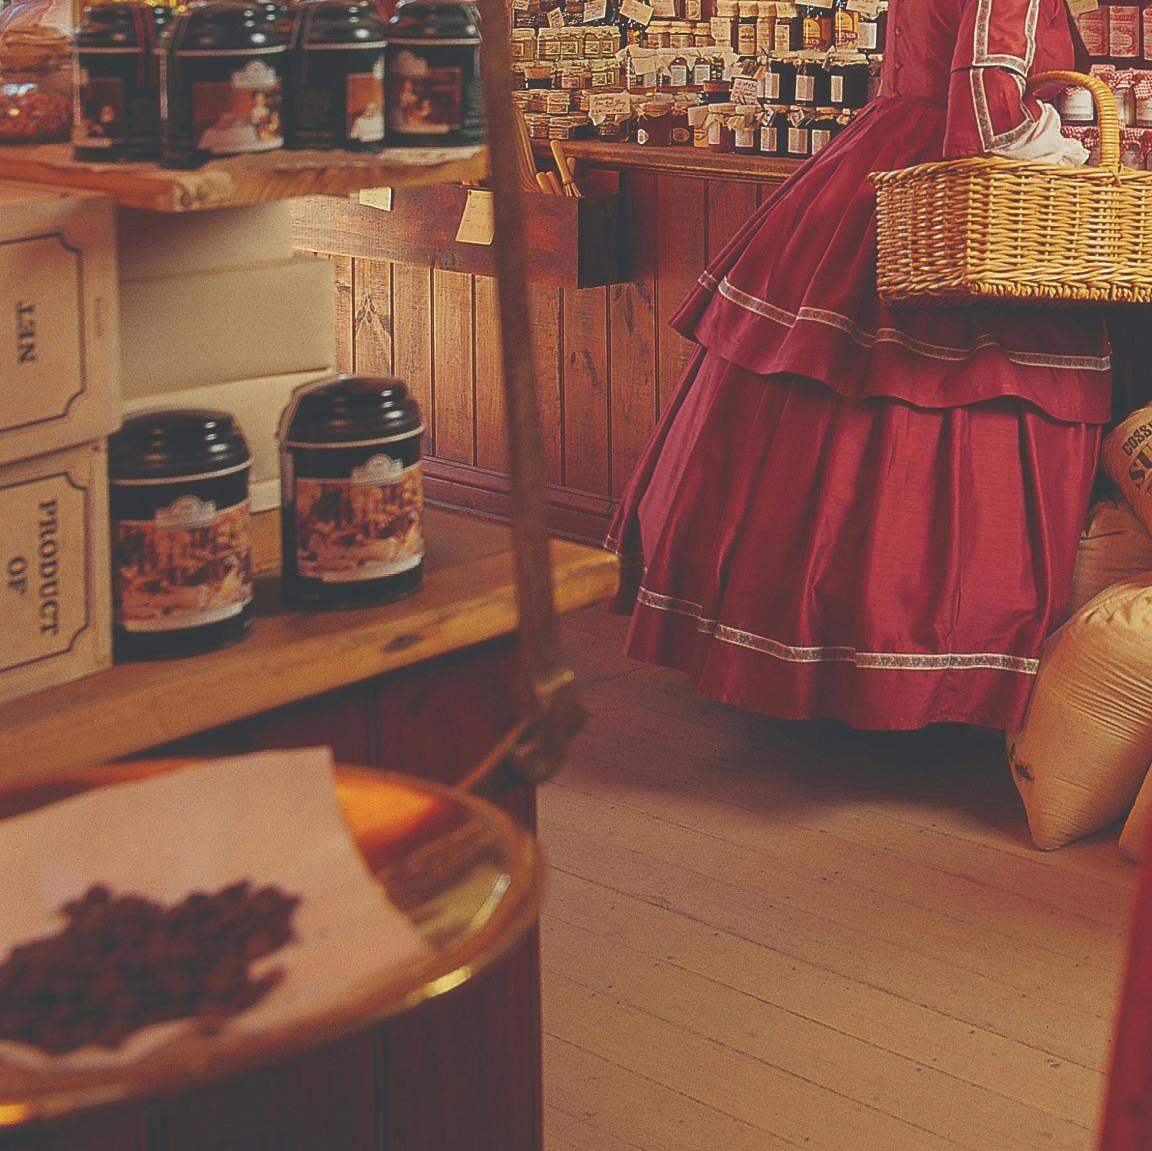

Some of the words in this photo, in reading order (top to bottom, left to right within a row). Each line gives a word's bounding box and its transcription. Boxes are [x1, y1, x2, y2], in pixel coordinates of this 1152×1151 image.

[15, 301, 37, 364] NET
[7, 555, 28, 595] OF
[37, 499, 60, 636] PRODUCT
